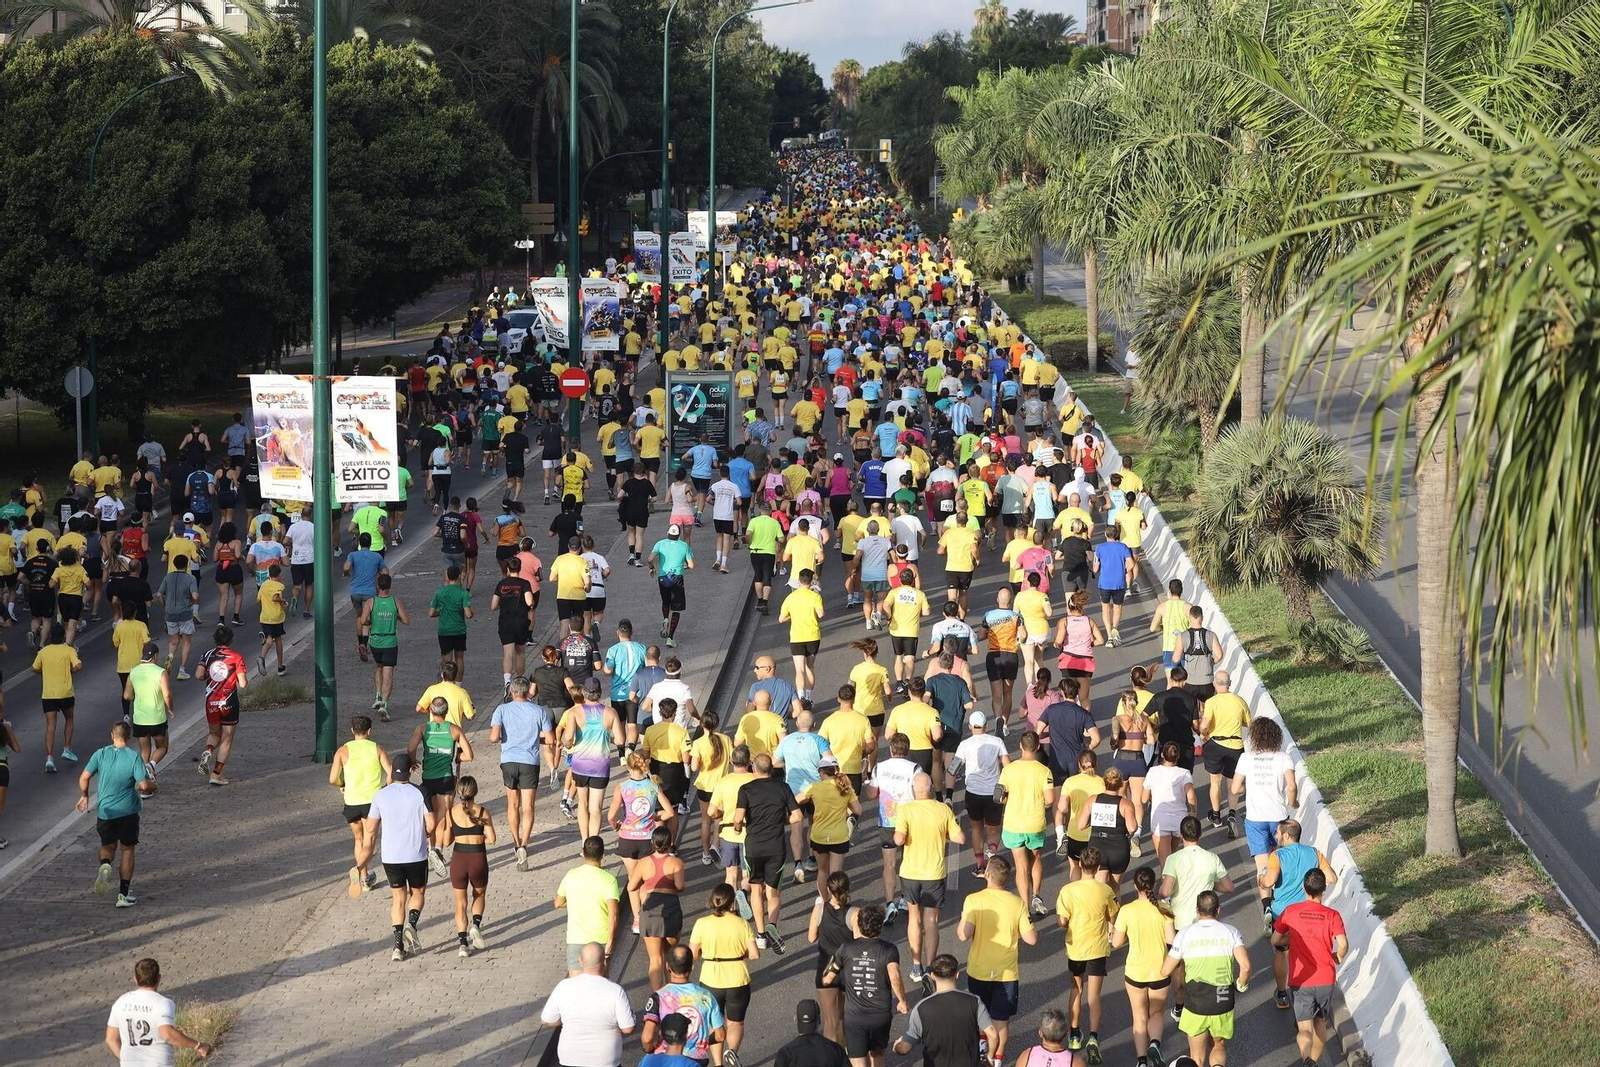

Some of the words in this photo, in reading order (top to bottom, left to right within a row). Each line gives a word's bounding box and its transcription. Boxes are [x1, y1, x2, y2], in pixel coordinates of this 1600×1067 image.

[709, 386, 726, 395] polo
[341, 460, 364, 468] VUELVE
[342, 467, 392, 482] ÉXITO
[899, 594, 915, 602] 5074
[1215, 967, 1230, 1004] TRAIL
[126, 1018, 154, 1047] 12
